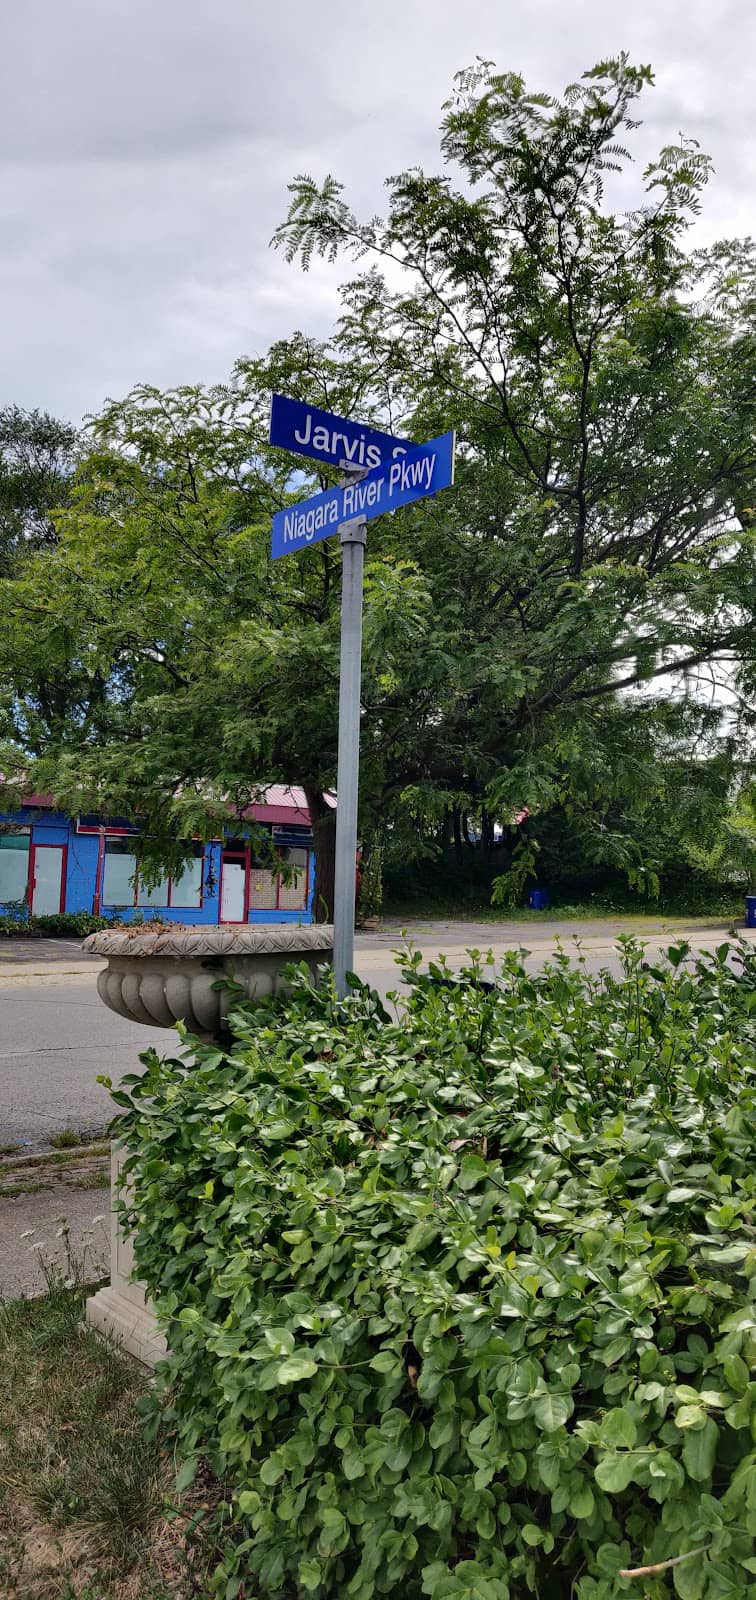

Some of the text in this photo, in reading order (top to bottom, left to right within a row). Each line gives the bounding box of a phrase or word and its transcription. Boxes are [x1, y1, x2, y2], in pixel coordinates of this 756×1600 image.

[294, 415, 381, 468] Jarvis
[283, 453, 436, 543] Niagara River Pkwy
